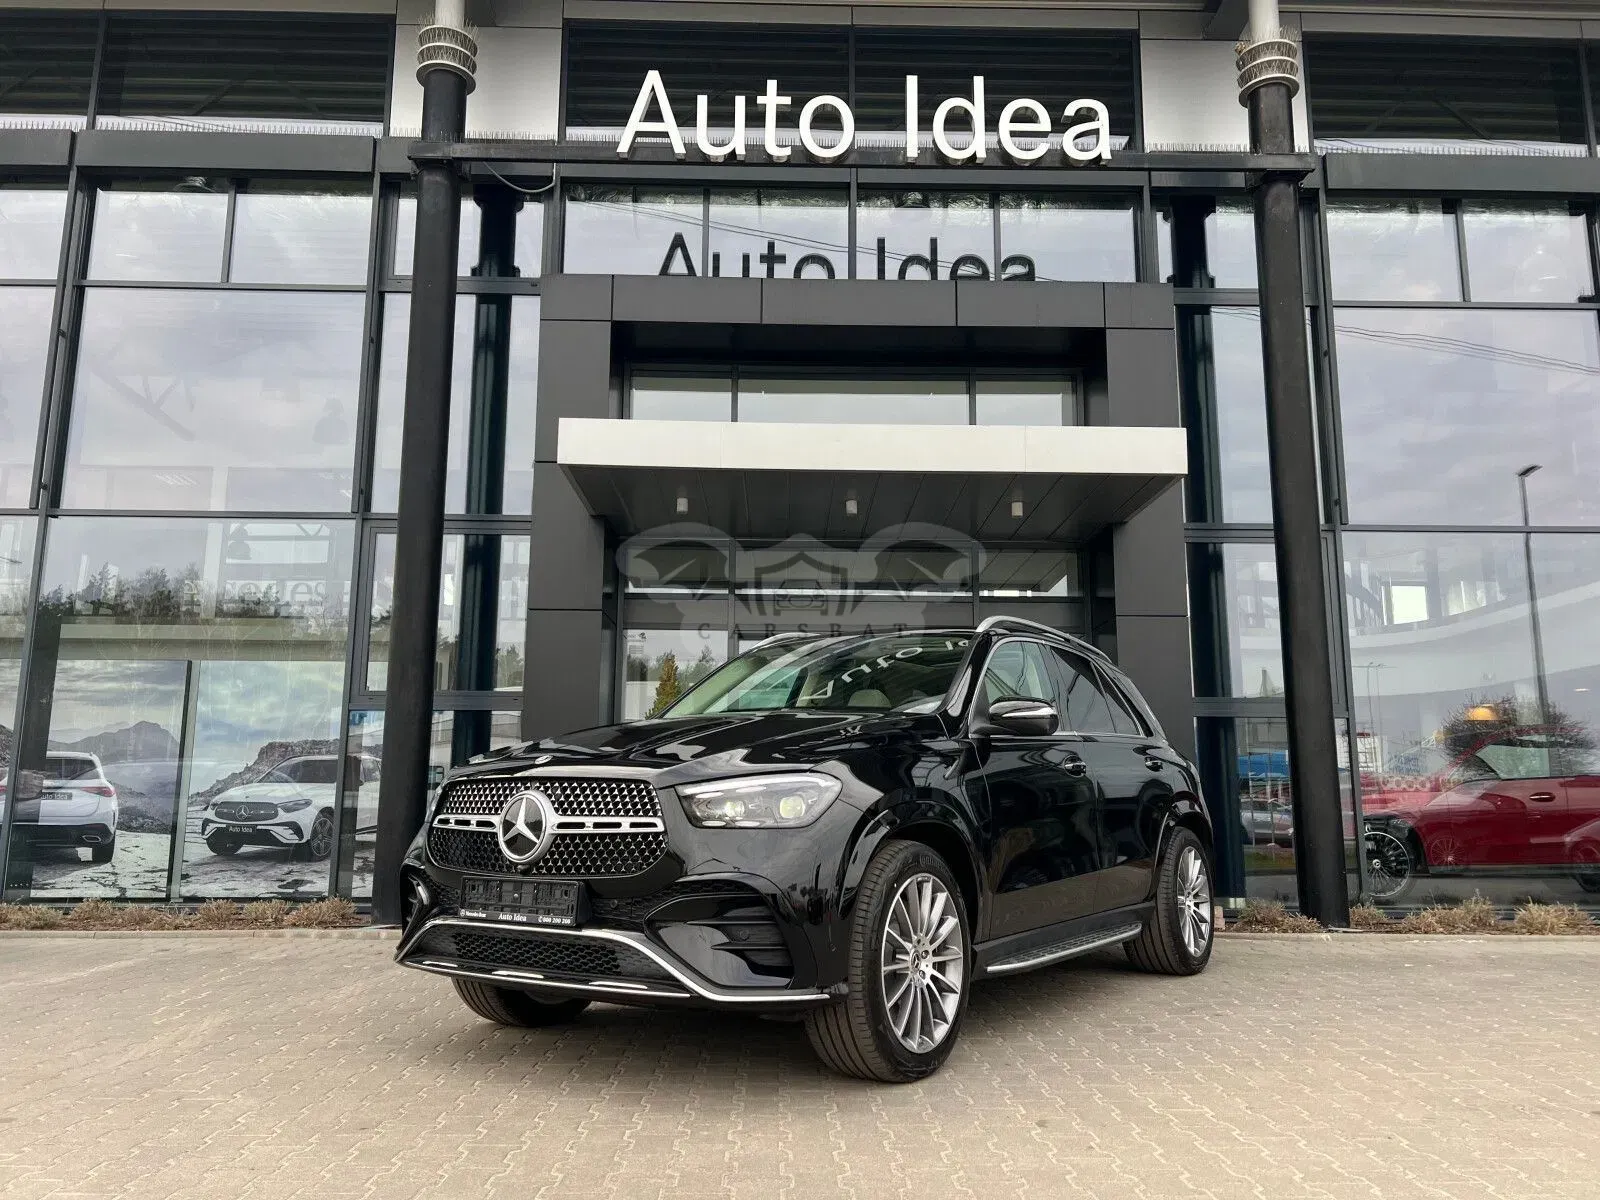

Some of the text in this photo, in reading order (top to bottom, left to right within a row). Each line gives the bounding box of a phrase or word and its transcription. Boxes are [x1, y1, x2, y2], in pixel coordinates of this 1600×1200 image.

[616, 70, 1112, 164] Auto Idea
[228, 825, 253, 833] Auto Idea
[498, 912, 513, 921] Auto
[513, 913, 527, 922] Idea
